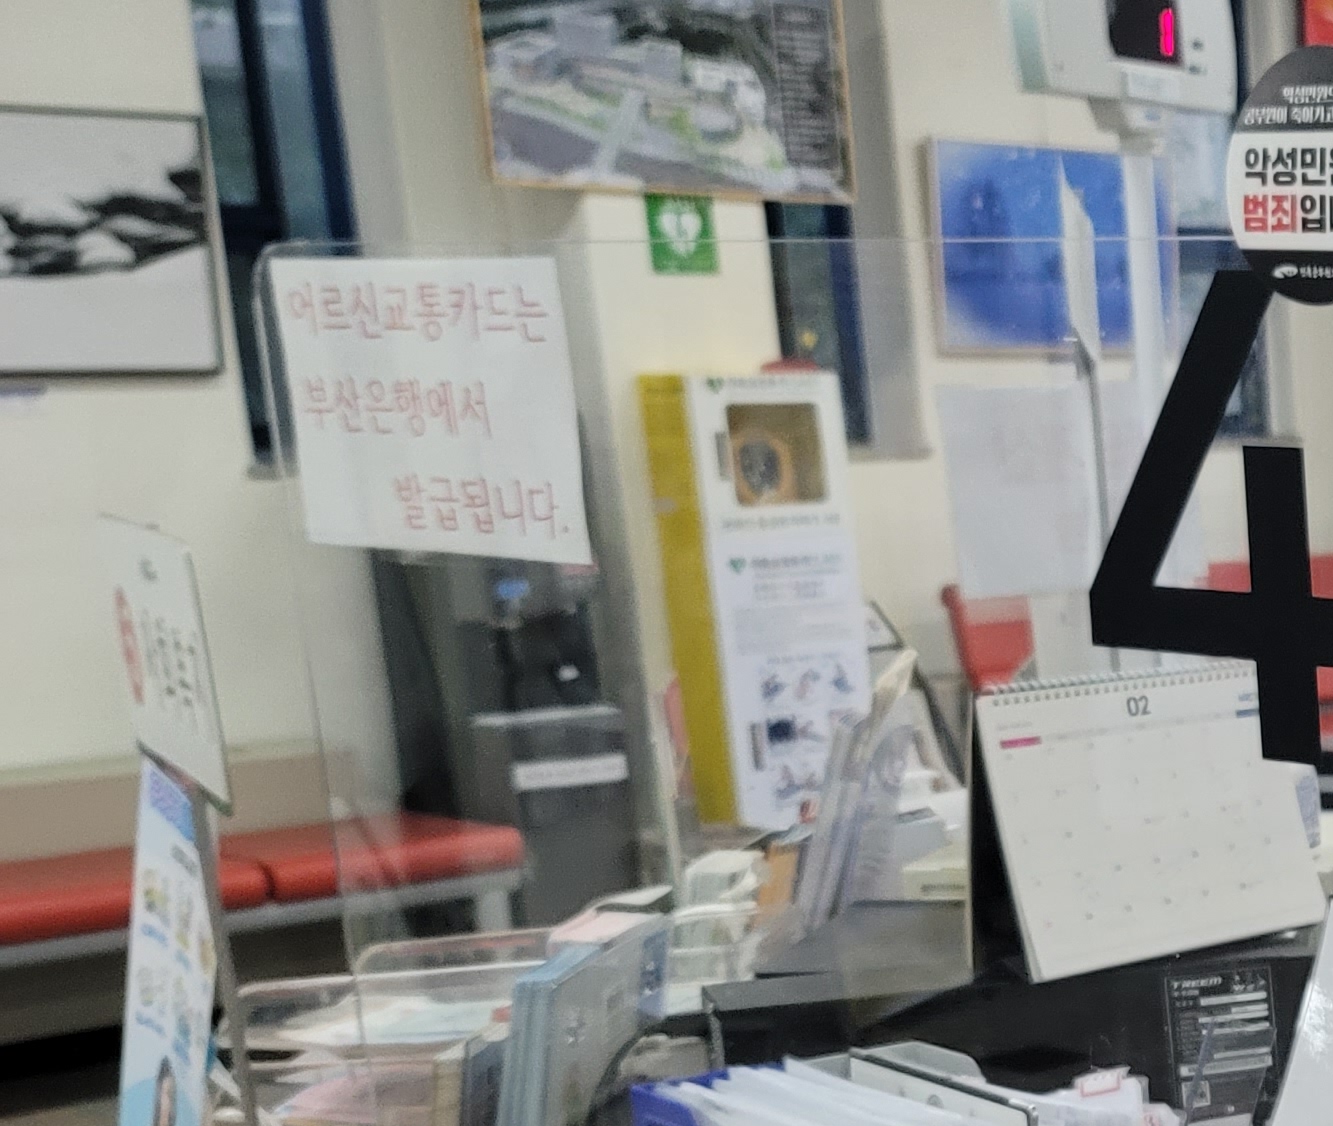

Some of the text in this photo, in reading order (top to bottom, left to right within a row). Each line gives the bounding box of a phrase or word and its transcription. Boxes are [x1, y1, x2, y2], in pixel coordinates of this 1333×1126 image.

[1244, 105, 1288, 125] 공무원이
[288, 281, 549, 343] 어르신교통카드는
[305, 375, 492, 439] 부산은행에서
[394, 473, 570, 540] 발급됩니다.
[1126, 695, 1150, 717] 02
